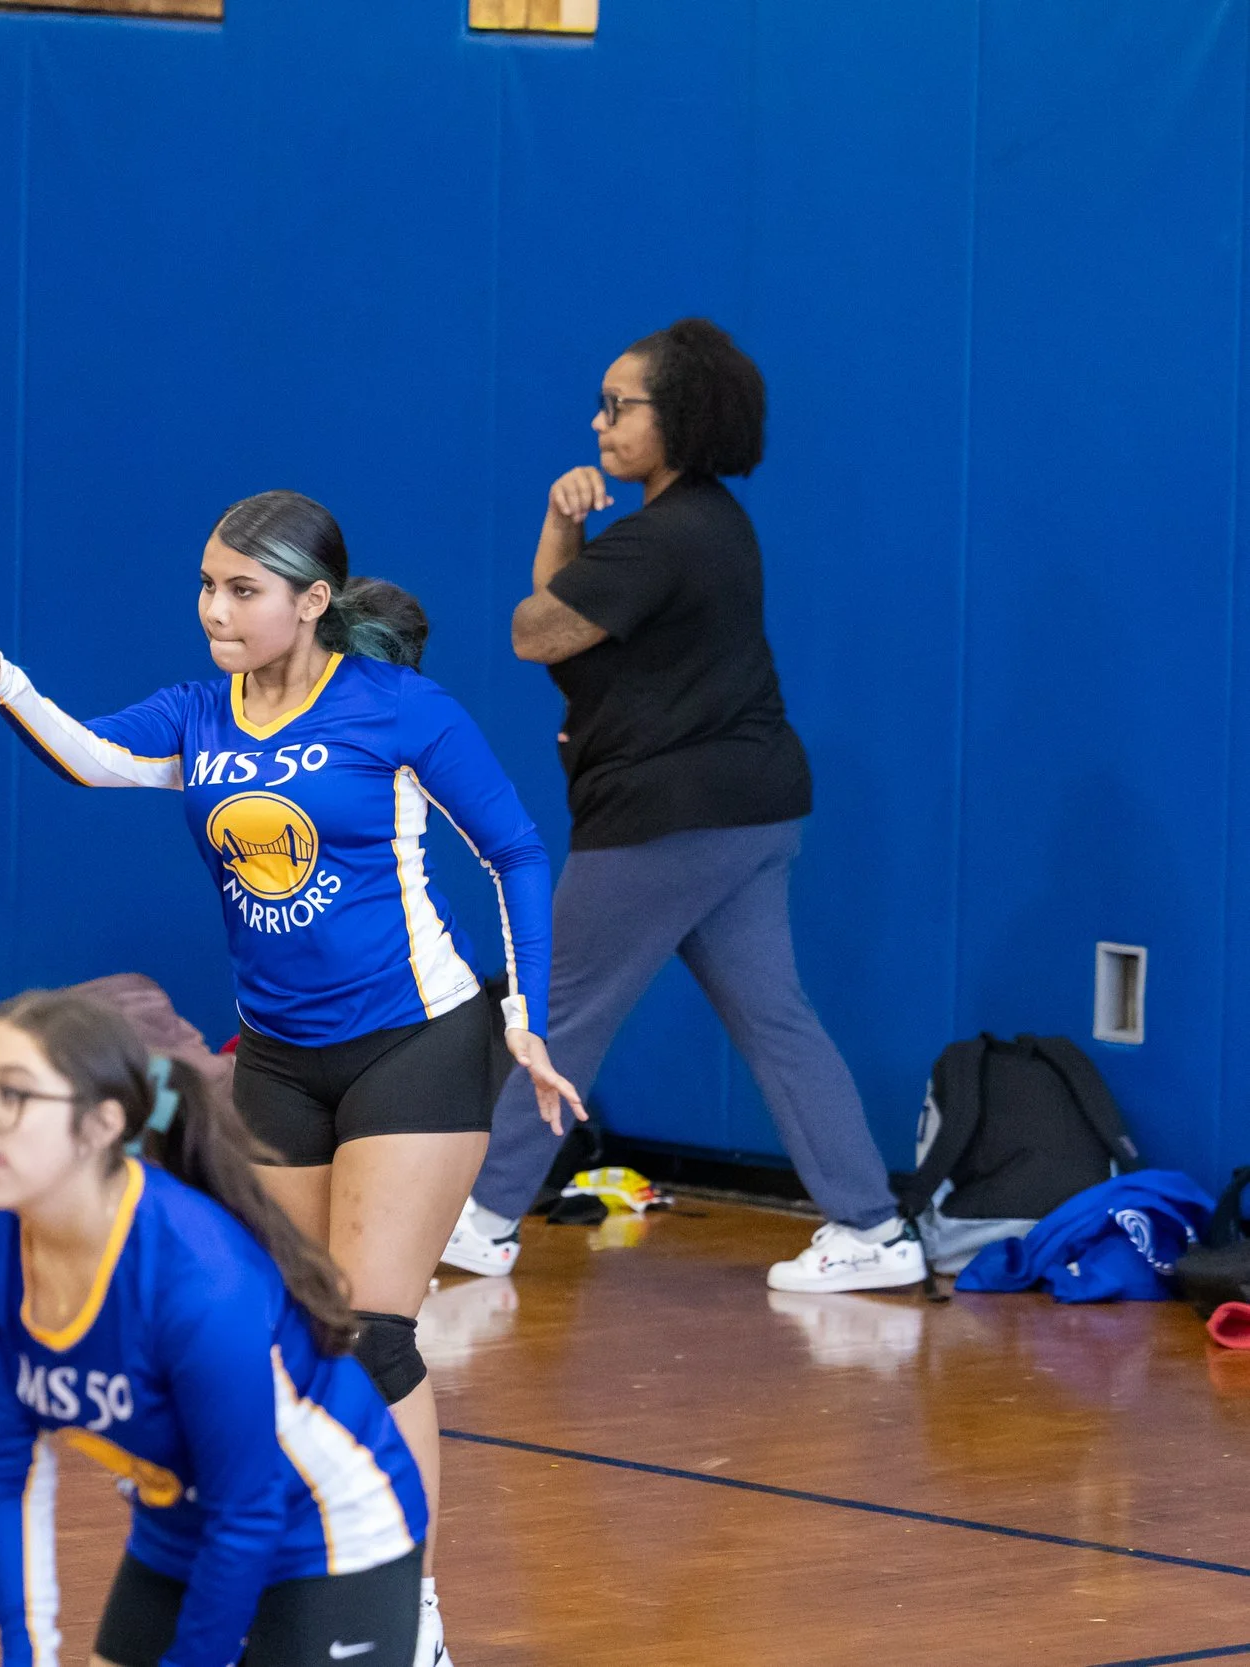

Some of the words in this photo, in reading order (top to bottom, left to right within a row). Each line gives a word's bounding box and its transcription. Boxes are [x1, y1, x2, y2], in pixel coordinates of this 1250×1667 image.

[188, 750, 263, 787] MS
[265, 743, 329, 787] 50
[16, 1352, 81, 1421] MS
[85, 1369, 135, 1432] 50
